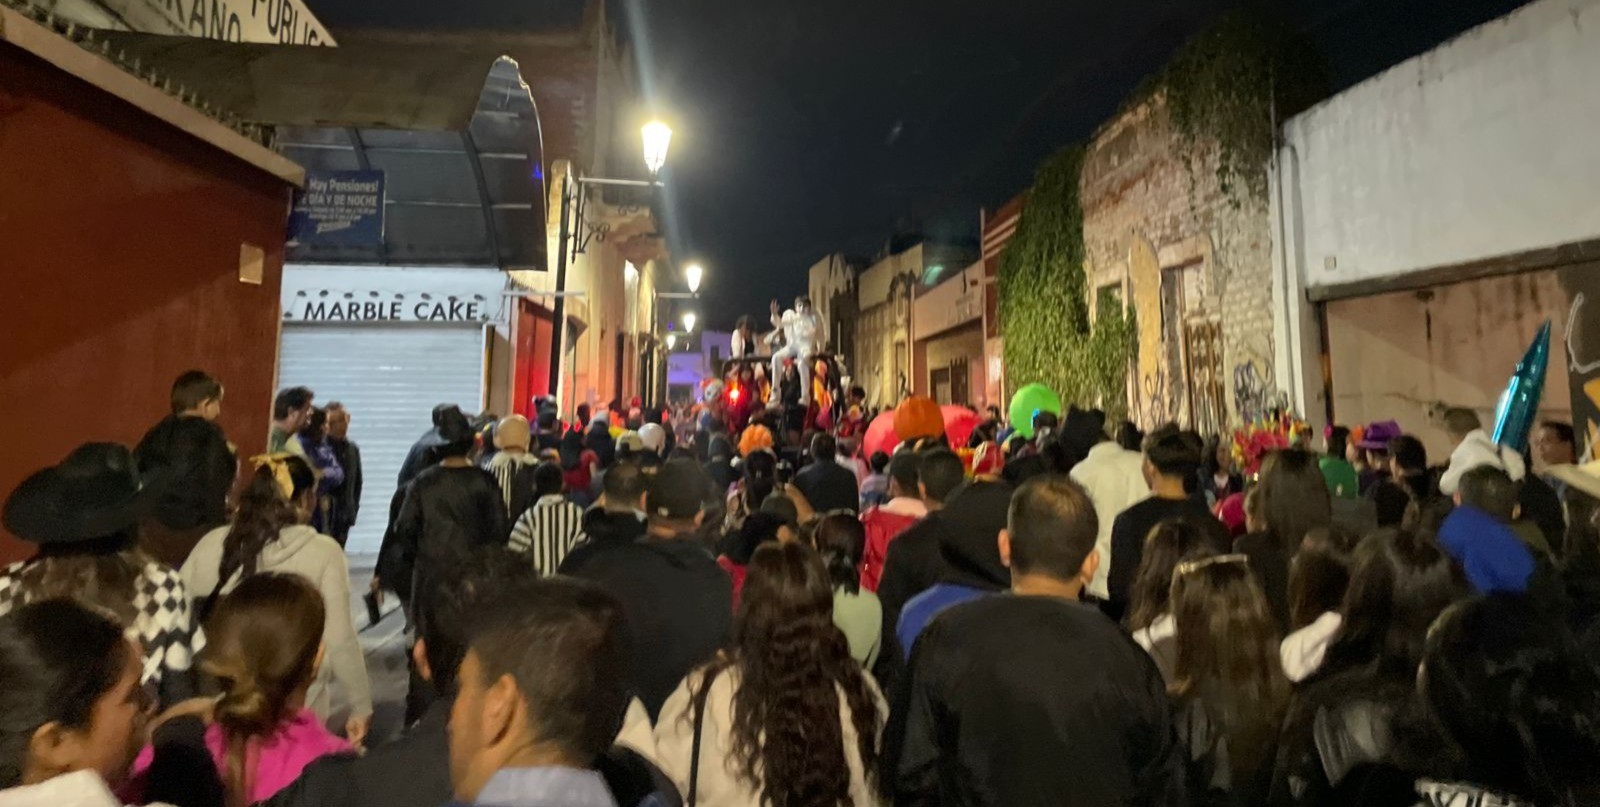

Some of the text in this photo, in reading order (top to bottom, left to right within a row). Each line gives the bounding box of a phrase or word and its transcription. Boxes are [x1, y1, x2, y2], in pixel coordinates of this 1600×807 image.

[347, 195, 377, 207] NOCHE
[304, 302, 478, 320] MARBLE CAKE
